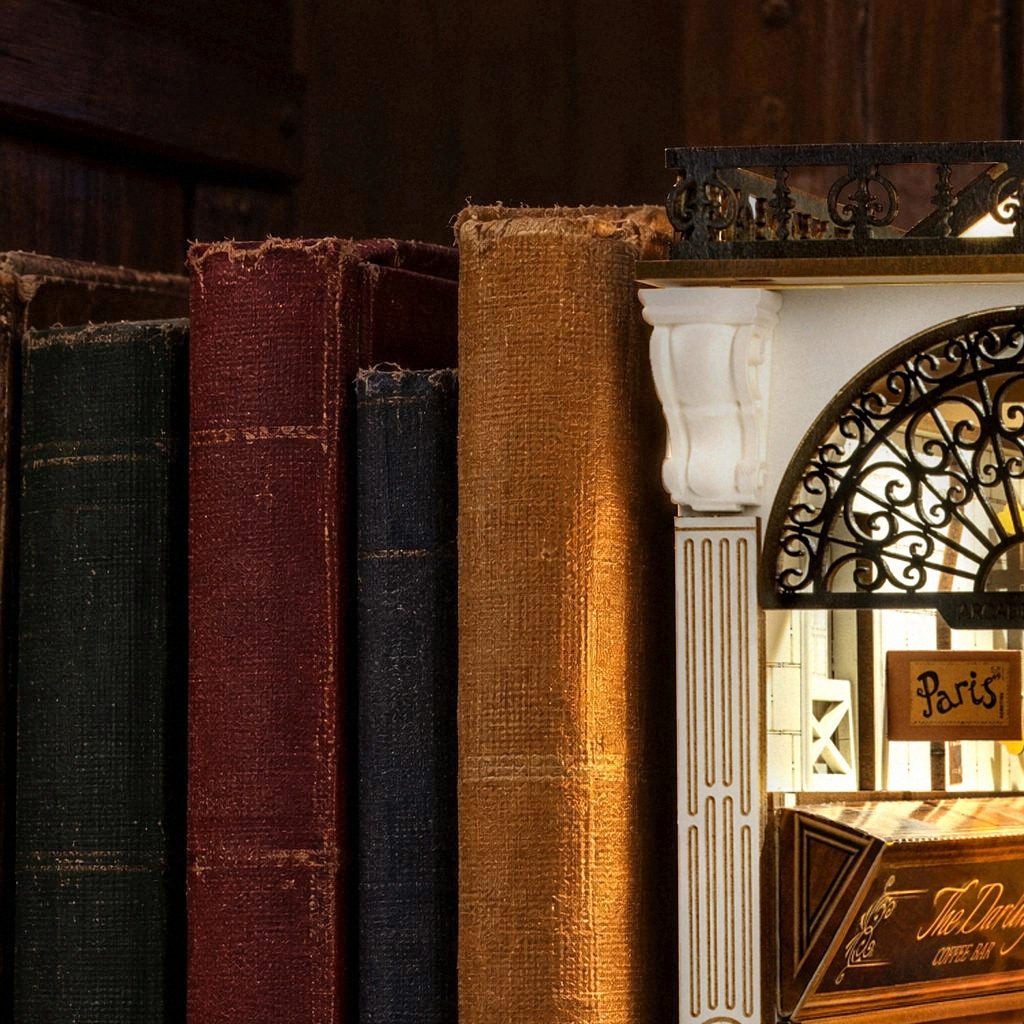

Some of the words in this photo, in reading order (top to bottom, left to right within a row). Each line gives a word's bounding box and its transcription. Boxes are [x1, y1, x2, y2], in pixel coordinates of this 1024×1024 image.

[917, 671, 998, 718] Paris
[917, 879, 979, 941] The
[932, 944, 974, 966] COFFEE
[969, 941, 995, 961] BAR
